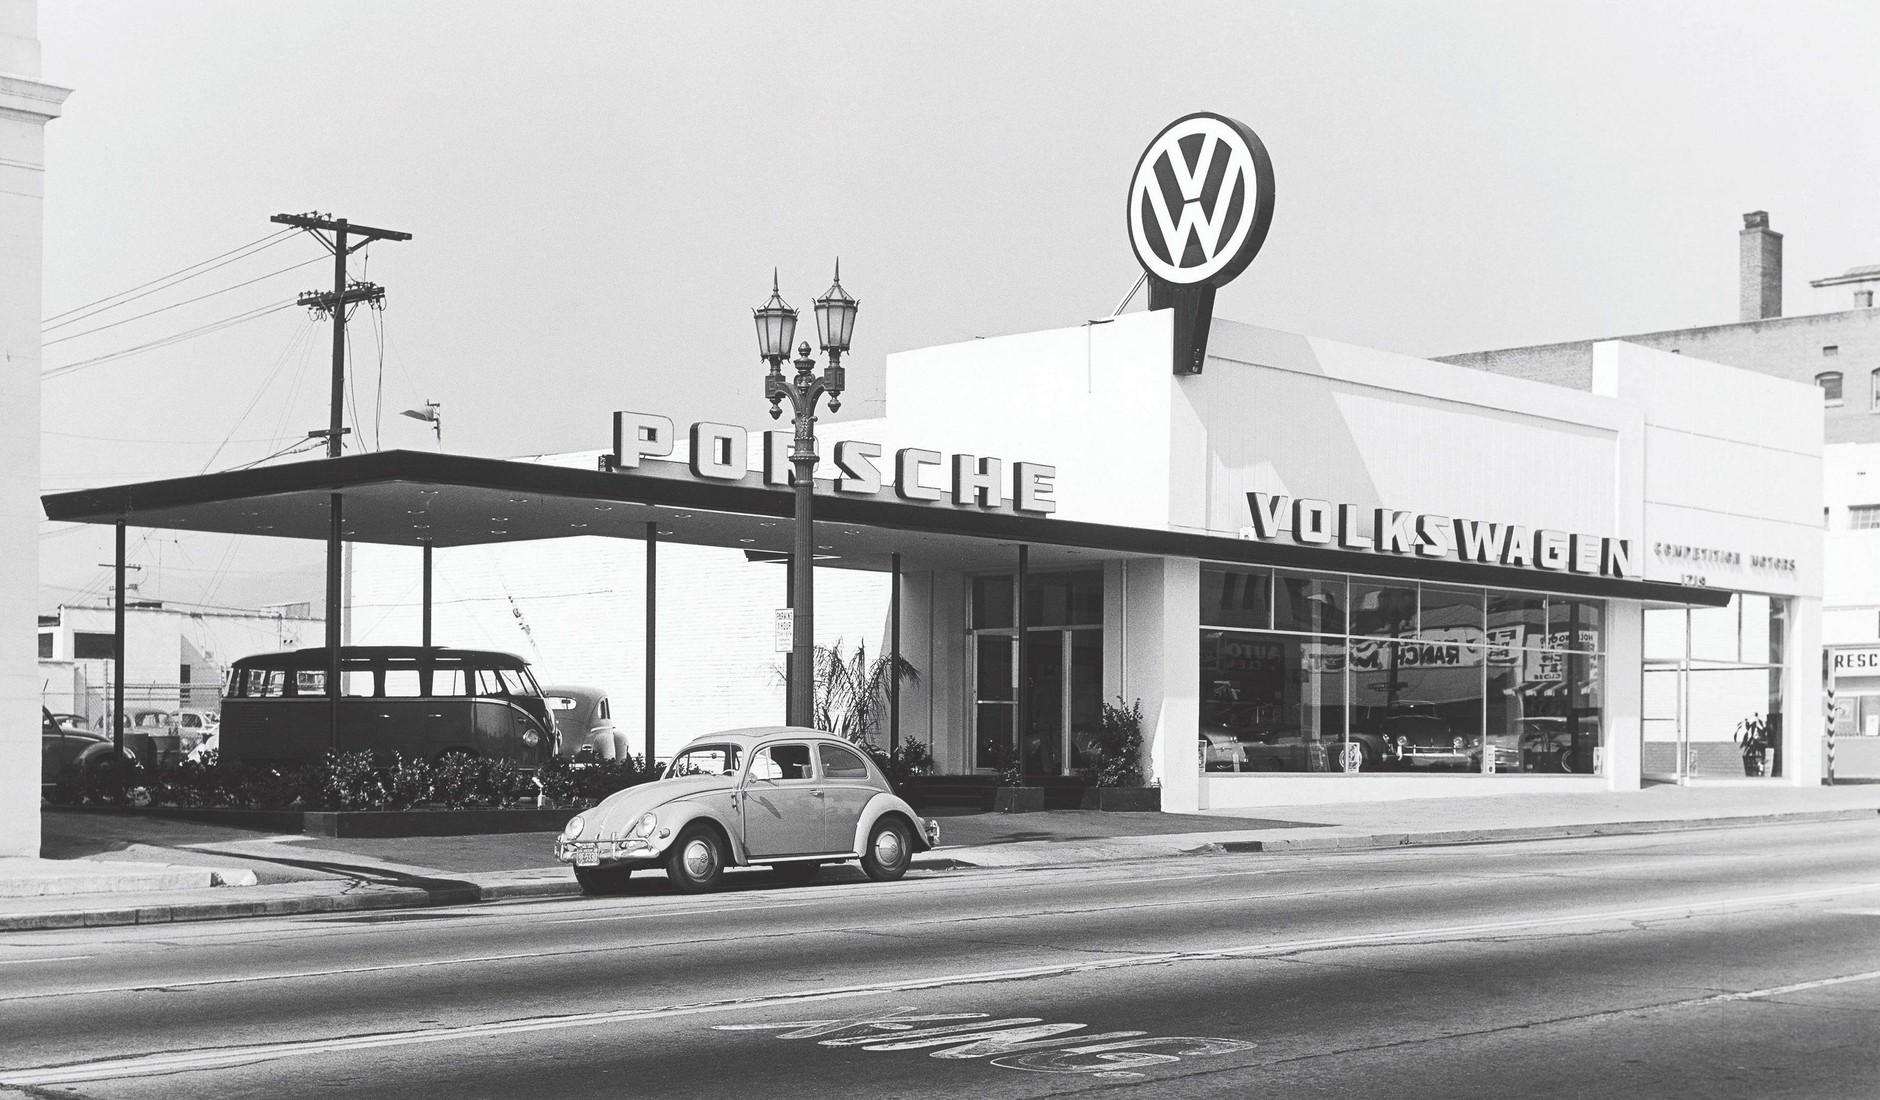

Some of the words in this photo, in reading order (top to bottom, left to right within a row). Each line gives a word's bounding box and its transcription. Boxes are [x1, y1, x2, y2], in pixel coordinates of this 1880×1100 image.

[1134, 121, 1253, 279] VW
[613, 410, 1056, 513] PORSCHE
[1246, 492, 1634, 577] VOLKSWAGEN
[1654, 542, 1741, 565] COMPETITION
[1750, 554, 1796, 571] MOTORS
[1681, 573, 1707, 587] 1719
[1834, 653, 1878, 668] RESC
